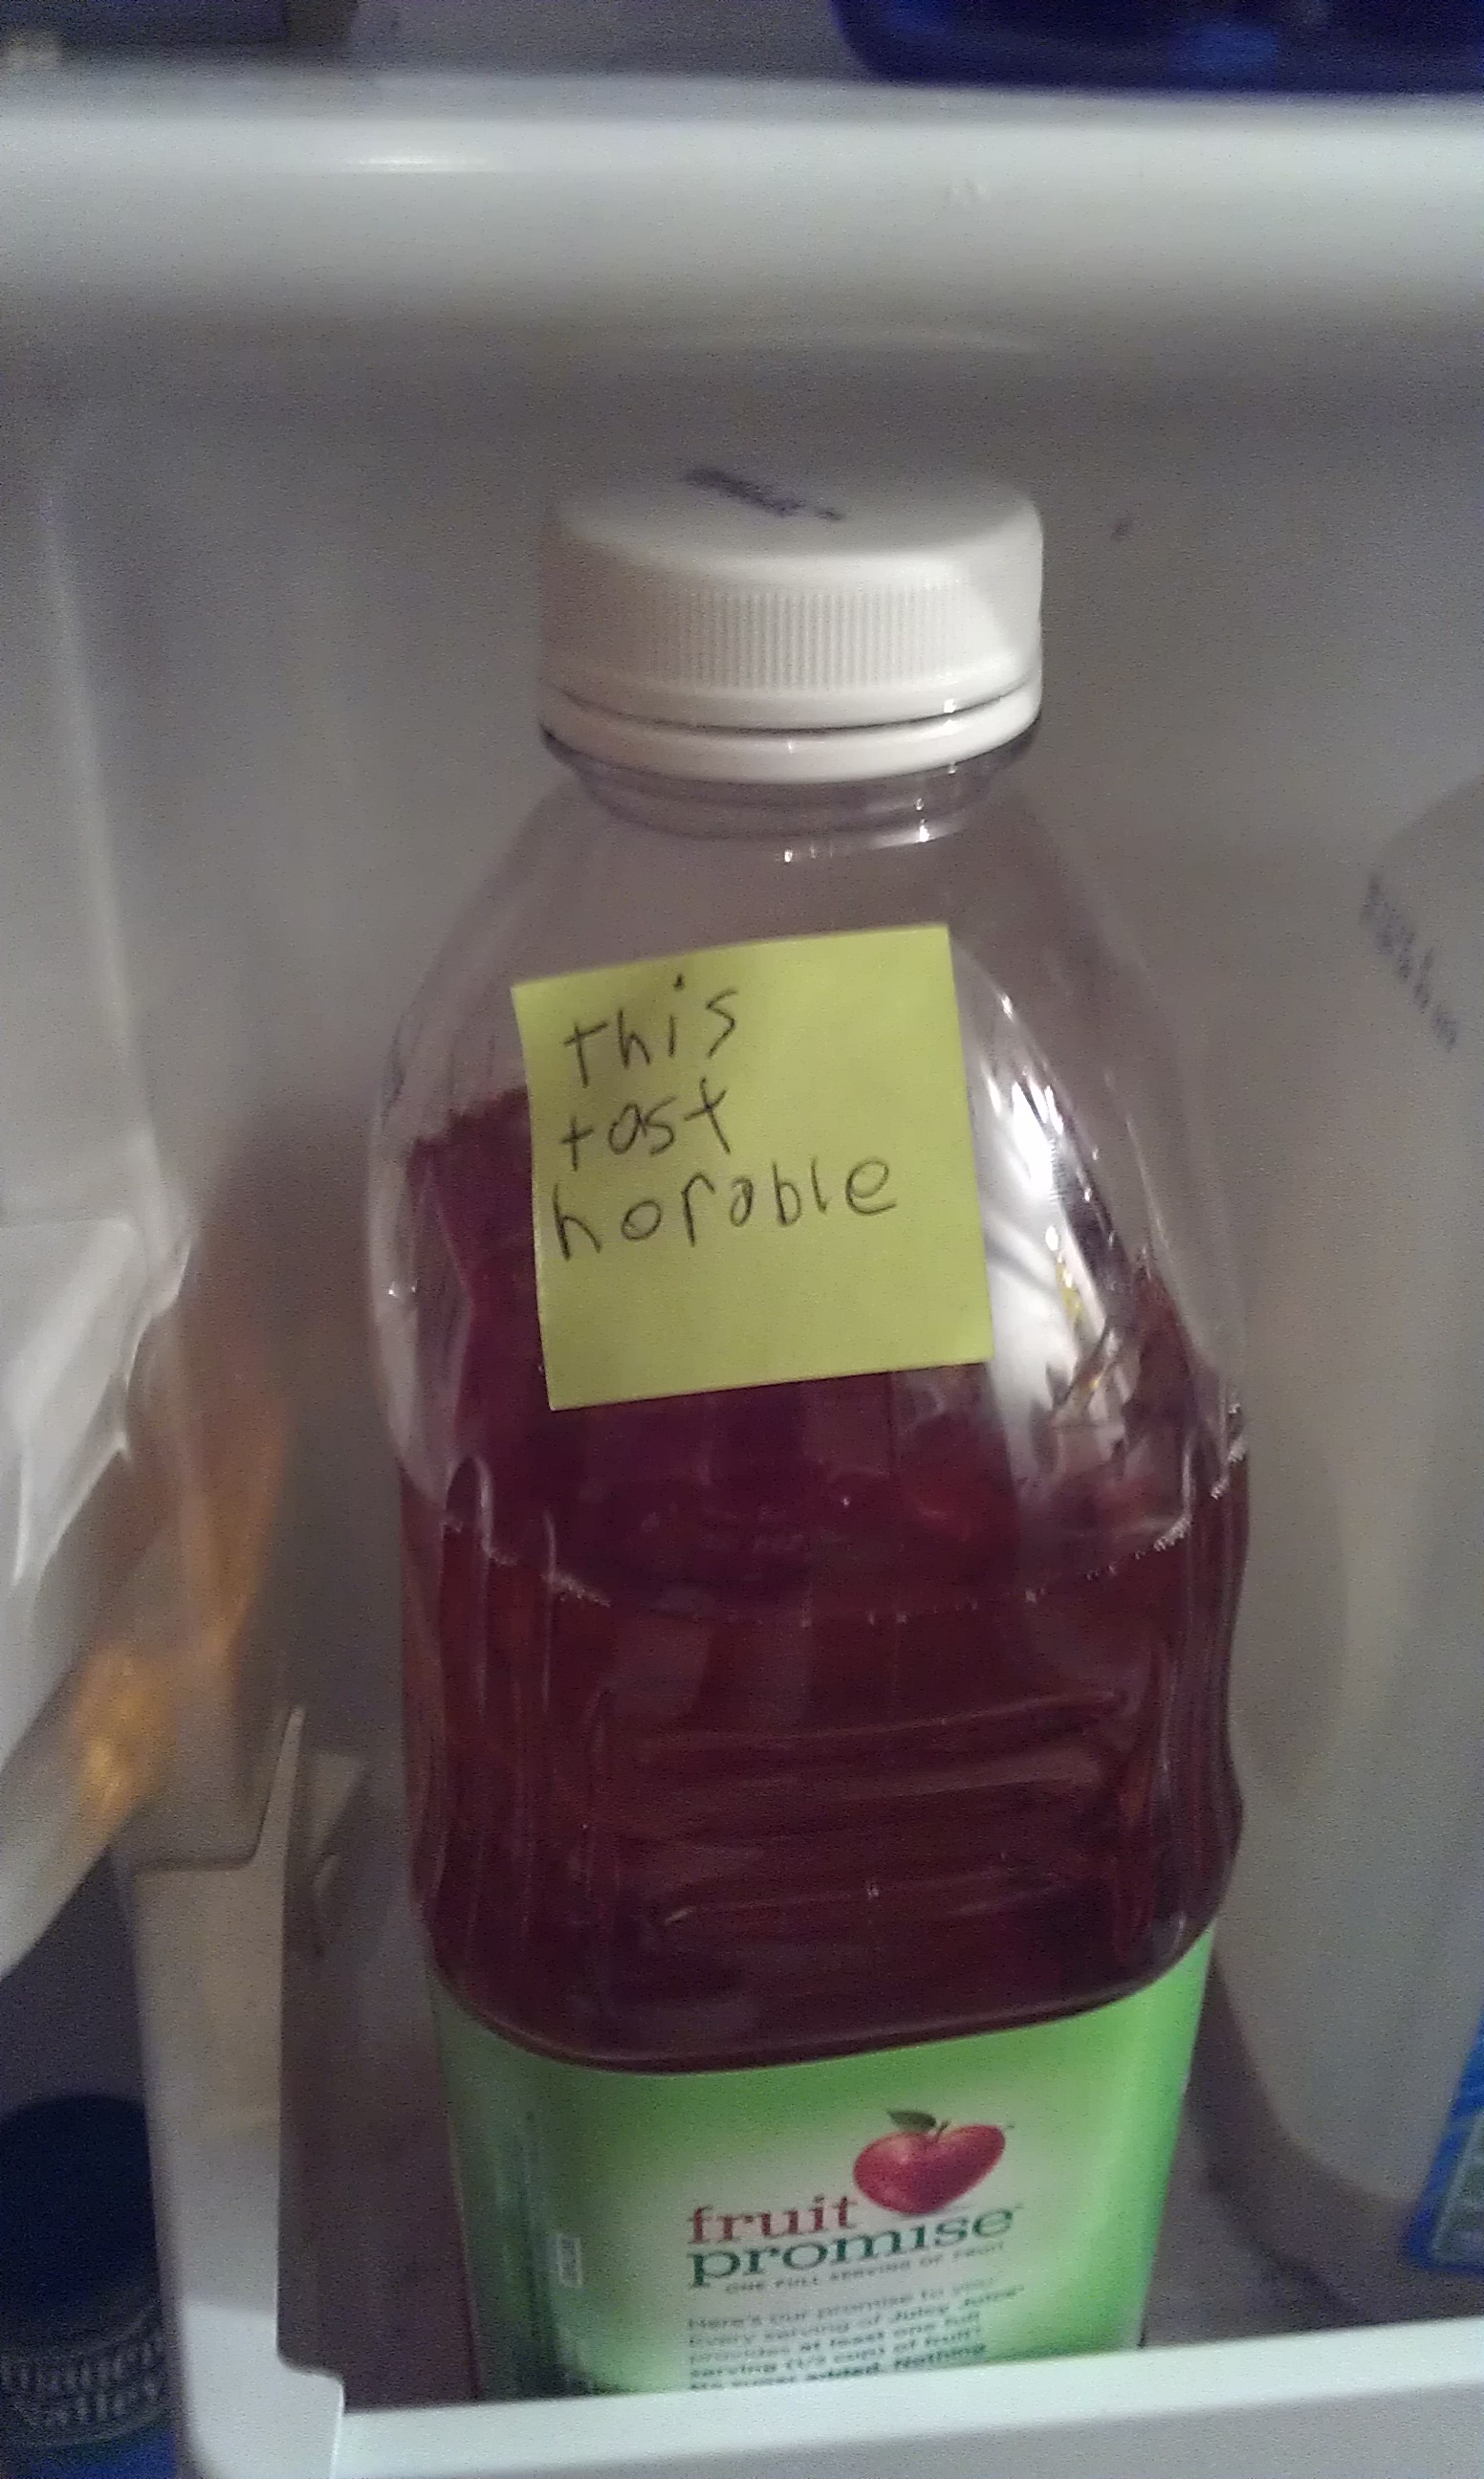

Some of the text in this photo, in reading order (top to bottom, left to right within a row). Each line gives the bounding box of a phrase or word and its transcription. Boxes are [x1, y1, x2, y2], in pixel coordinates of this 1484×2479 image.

[562, 973, 738, 1089] this
[560, 1077, 732, 1173] tast
[552, 1154, 897, 1261] horable
[686, 2205, 1015, 2289] promise
[687, 2195, 859, 2245] fruit
